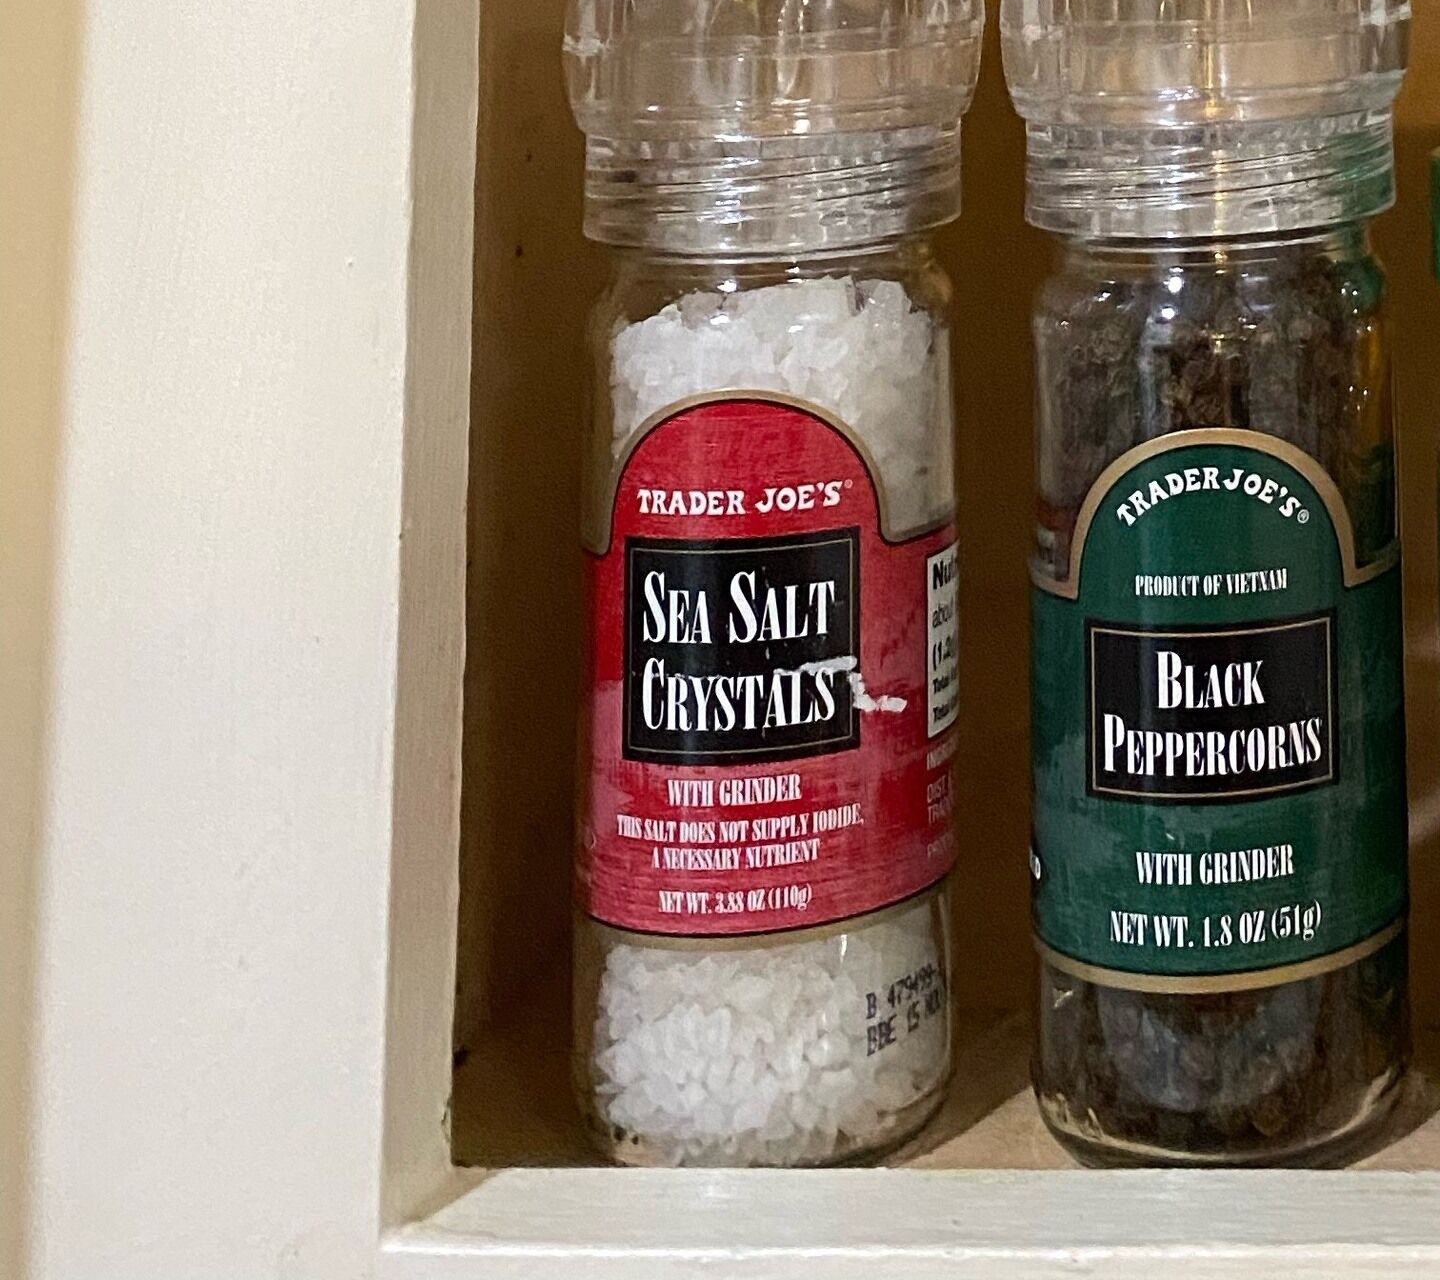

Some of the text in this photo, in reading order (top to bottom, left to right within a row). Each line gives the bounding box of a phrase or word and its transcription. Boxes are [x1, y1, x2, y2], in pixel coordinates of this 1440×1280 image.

[636, 488, 745, 515] TRADER
[1116, 468, 1220, 526] TRADER
[1135, 568, 1288, 596] PRODUCT OF VIETNAM
[1156, 650, 1265, 710] BLACK
[1102, 712, 1322, 778] PEPPERCORNS
[667, 774, 801, 807] WITH GRINDER
[616, 815, 642, 838] THIS
[644, 820, 676, 841] SALT
[680, 821, 715, 843] DOES
[719, 821, 749, 842] NOT
[752, 813, 810, 841] SUPPLY
[652, 839, 821, 870] A NECESSARY NUTRIENT
[1136, 844, 1294, 885] WITH GRINDER
[659, 891, 684, 912] NET
[686, 891, 712, 914] WT.
[747, 890, 765, 911] OZ
[768, 883, 813, 911] (110g)
[1110, 900, 1322, 948] NET WT. 1.8 OZ (51g)
